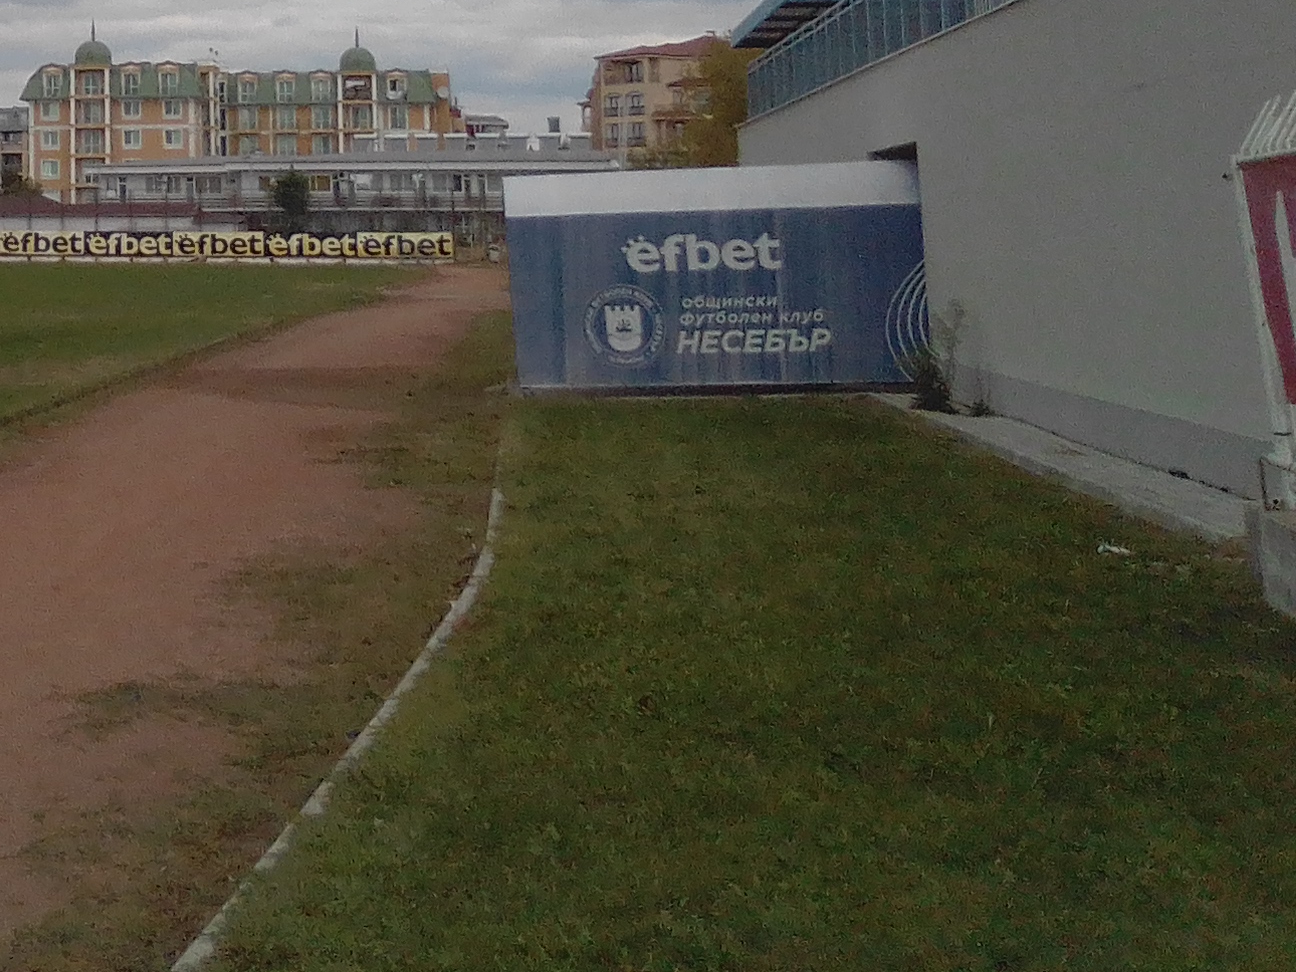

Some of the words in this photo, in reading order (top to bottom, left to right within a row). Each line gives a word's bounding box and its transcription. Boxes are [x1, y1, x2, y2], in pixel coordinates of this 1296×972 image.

[2, 232, 83, 253] efbet
[87, 232, 172, 255] efbet
[175, 233, 262, 255] efbet
[266, 234, 357, 256] efbet
[360, 235, 452, 256] efbet
[622, 232, 783, 273] efbet
[778, 308, 825, 326] клуб
[676, 327, 833, 355] НЕСЕБЪР
